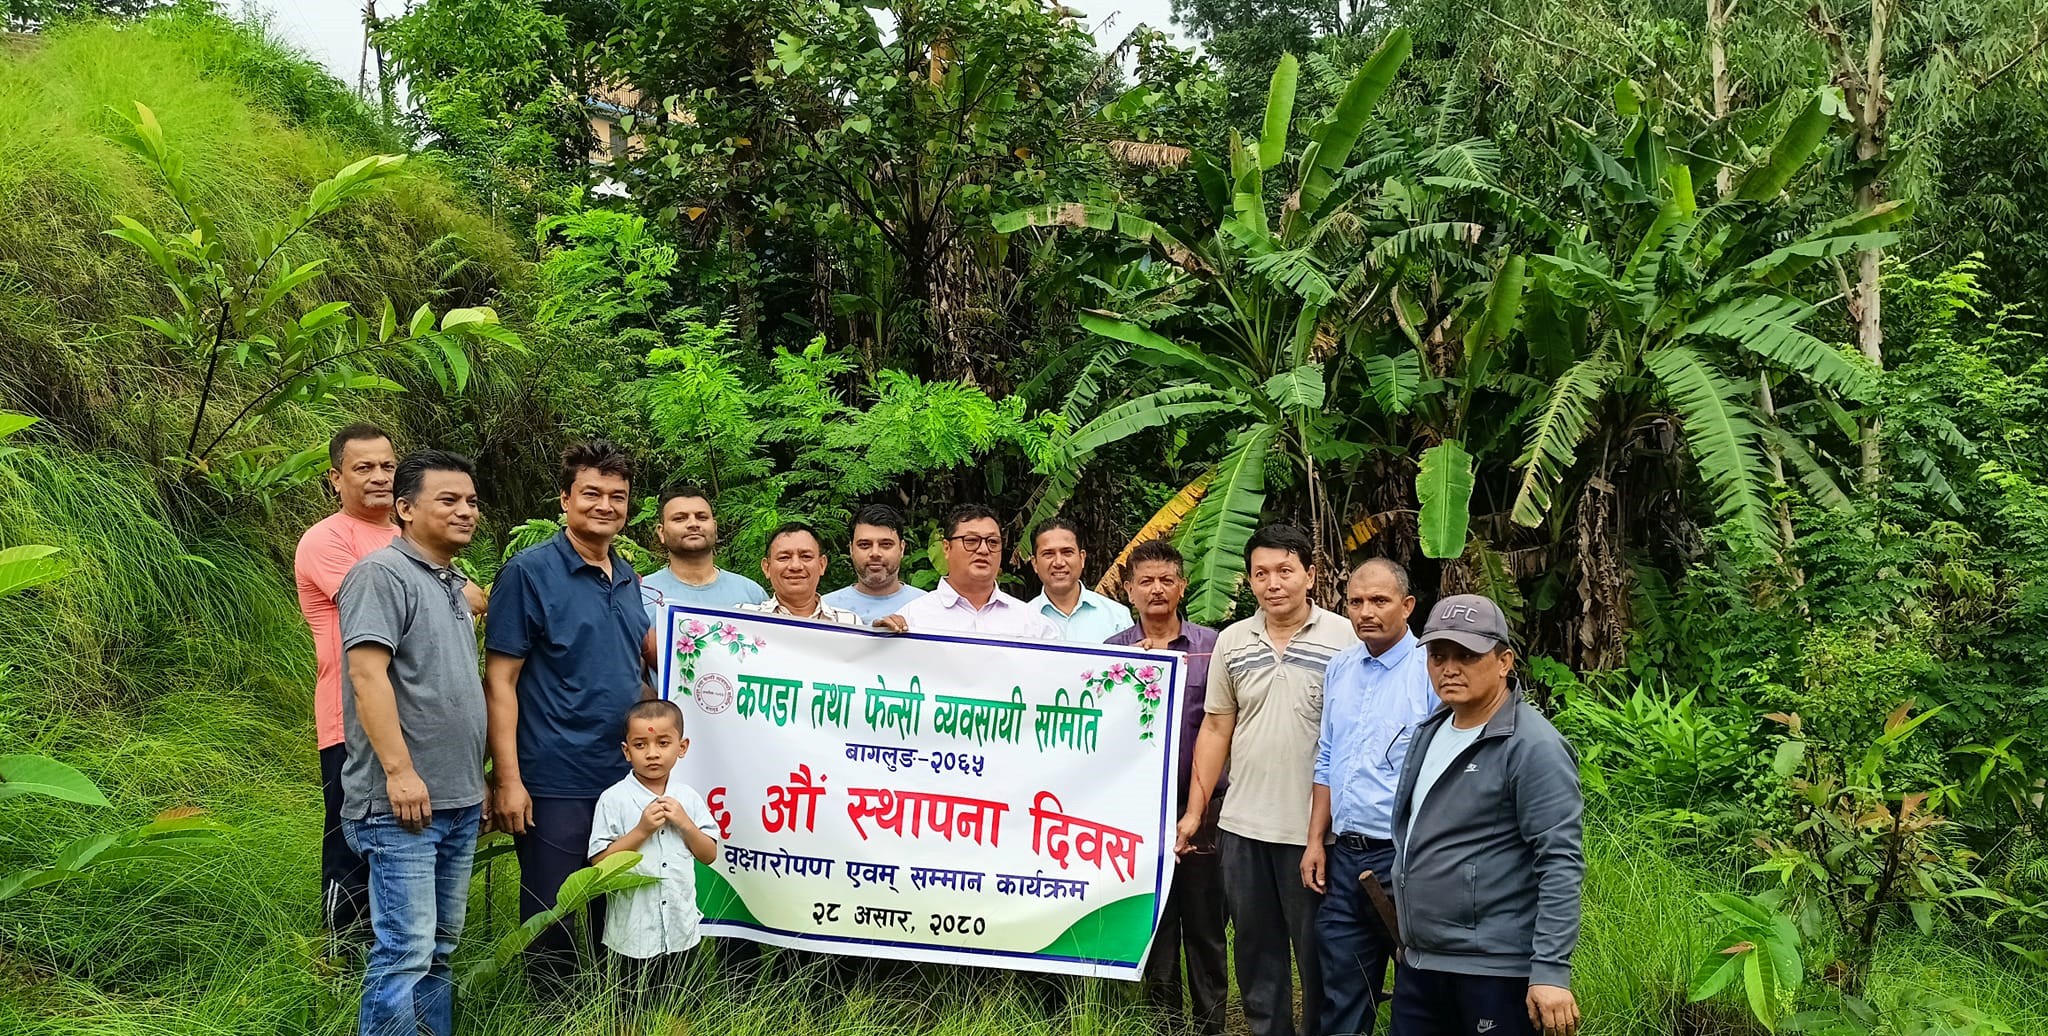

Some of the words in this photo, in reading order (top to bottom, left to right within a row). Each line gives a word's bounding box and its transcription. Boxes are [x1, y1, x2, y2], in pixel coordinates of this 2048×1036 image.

[1440, 604, 1478, 623] UFC
[736, 674, 803, 727] कपडा
[811, 682, 855, 729] तथा
[864, 675, 925, 740] फेन्सी
[934, 685, 1027, 747] व्यवसायी
[1035, 687, 1103, 754] समिति
[761, 763, 827, 833] औं
[847, 786, 1010, 848] स्थापना
[1029, 790, 1144, 883] दिवस
[723, 844, 835, 879] वृक्षारोपण
[846, 860, 899, 893] एवम्
[910, 866, 986, 893] सम्मान
[995, 869, 1090, 901] कार्यक्रम
[812, 902, 842, 925] २८
[854, 905, 916, 935] असार,
[929, 913, 986, 936] २०८०
